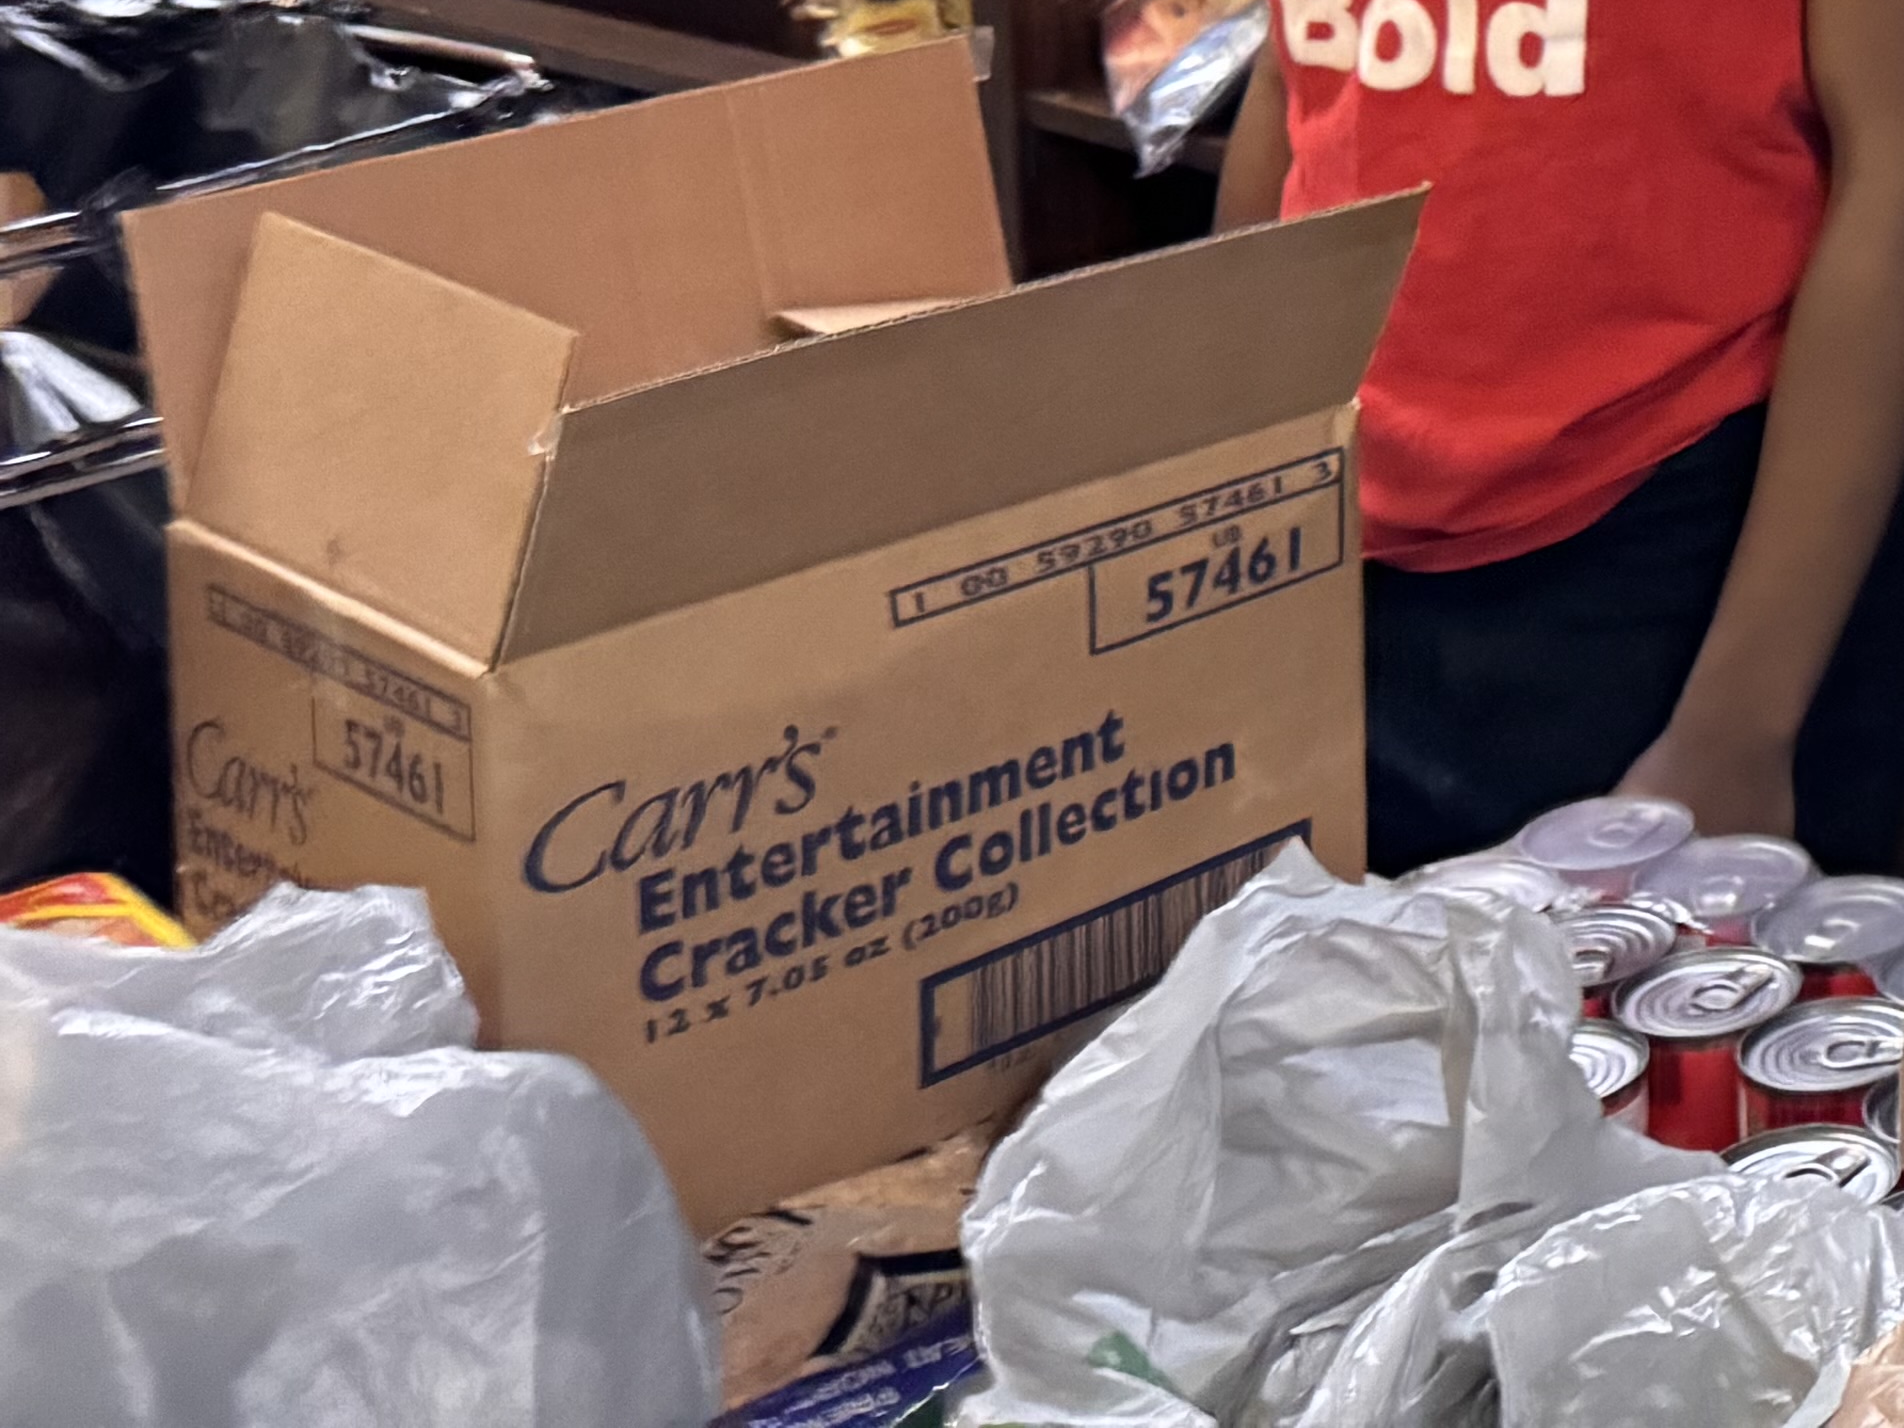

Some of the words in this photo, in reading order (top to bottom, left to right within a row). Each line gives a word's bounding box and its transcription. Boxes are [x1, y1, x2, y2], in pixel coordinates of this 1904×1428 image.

[1037, 521, 1153, 570] 59290
[1177, 476, 1283, 525] 57461
[1315, 462, 1332, 482] 3
[1145, 527, 1300, 623] 57461
[346, 720, 442, 815] 57461
[523, 724, 822, 894] Carr's
[638, 709, 1126, 933] Entertainment
[638, 867, 912, 1002] Cracker
[933, 741, 1235, 892] Collection
[647, 1011, 690, 1044] 12
[746, 963, 828, 1006] 7.05
[904, 882, 1020, 949] (200g)
